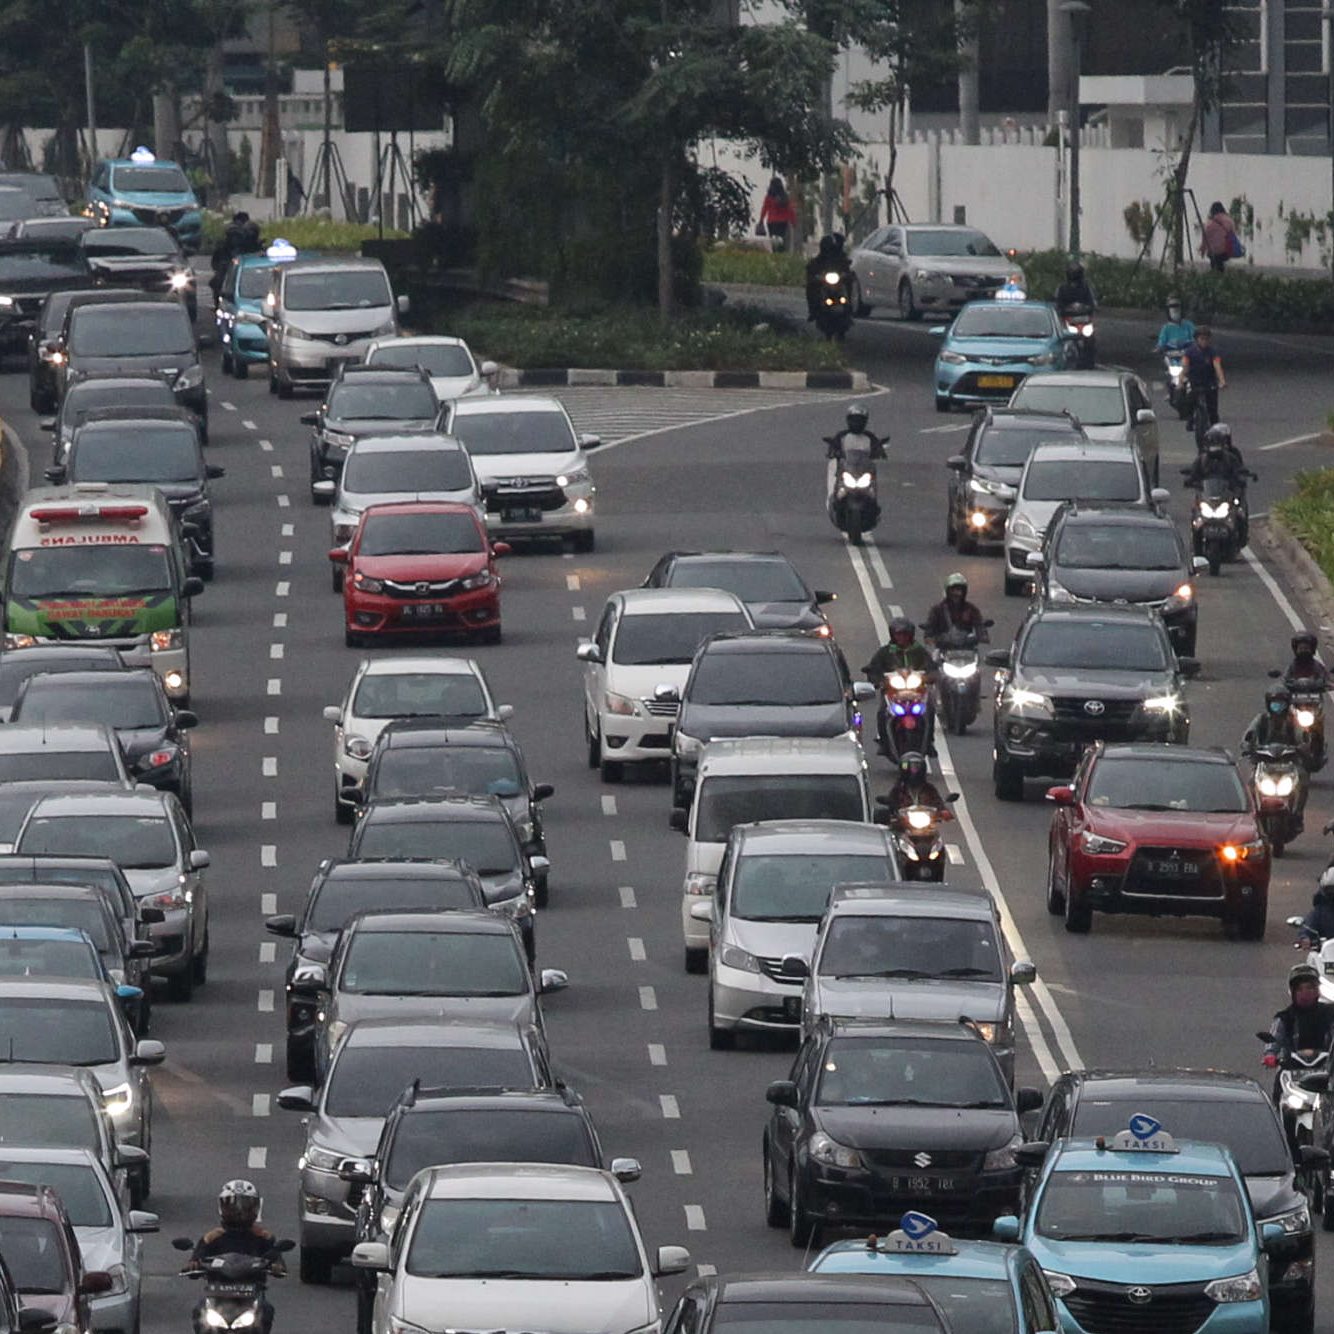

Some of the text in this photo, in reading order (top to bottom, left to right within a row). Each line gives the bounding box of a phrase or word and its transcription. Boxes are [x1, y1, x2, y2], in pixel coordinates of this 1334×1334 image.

[1123, 1139, 1166, 1150] TAKSI
[1093, 1173, 1219, 1187] BLUE BIRD GROUP
[896, 1239, 943, 1250] TAKSI
